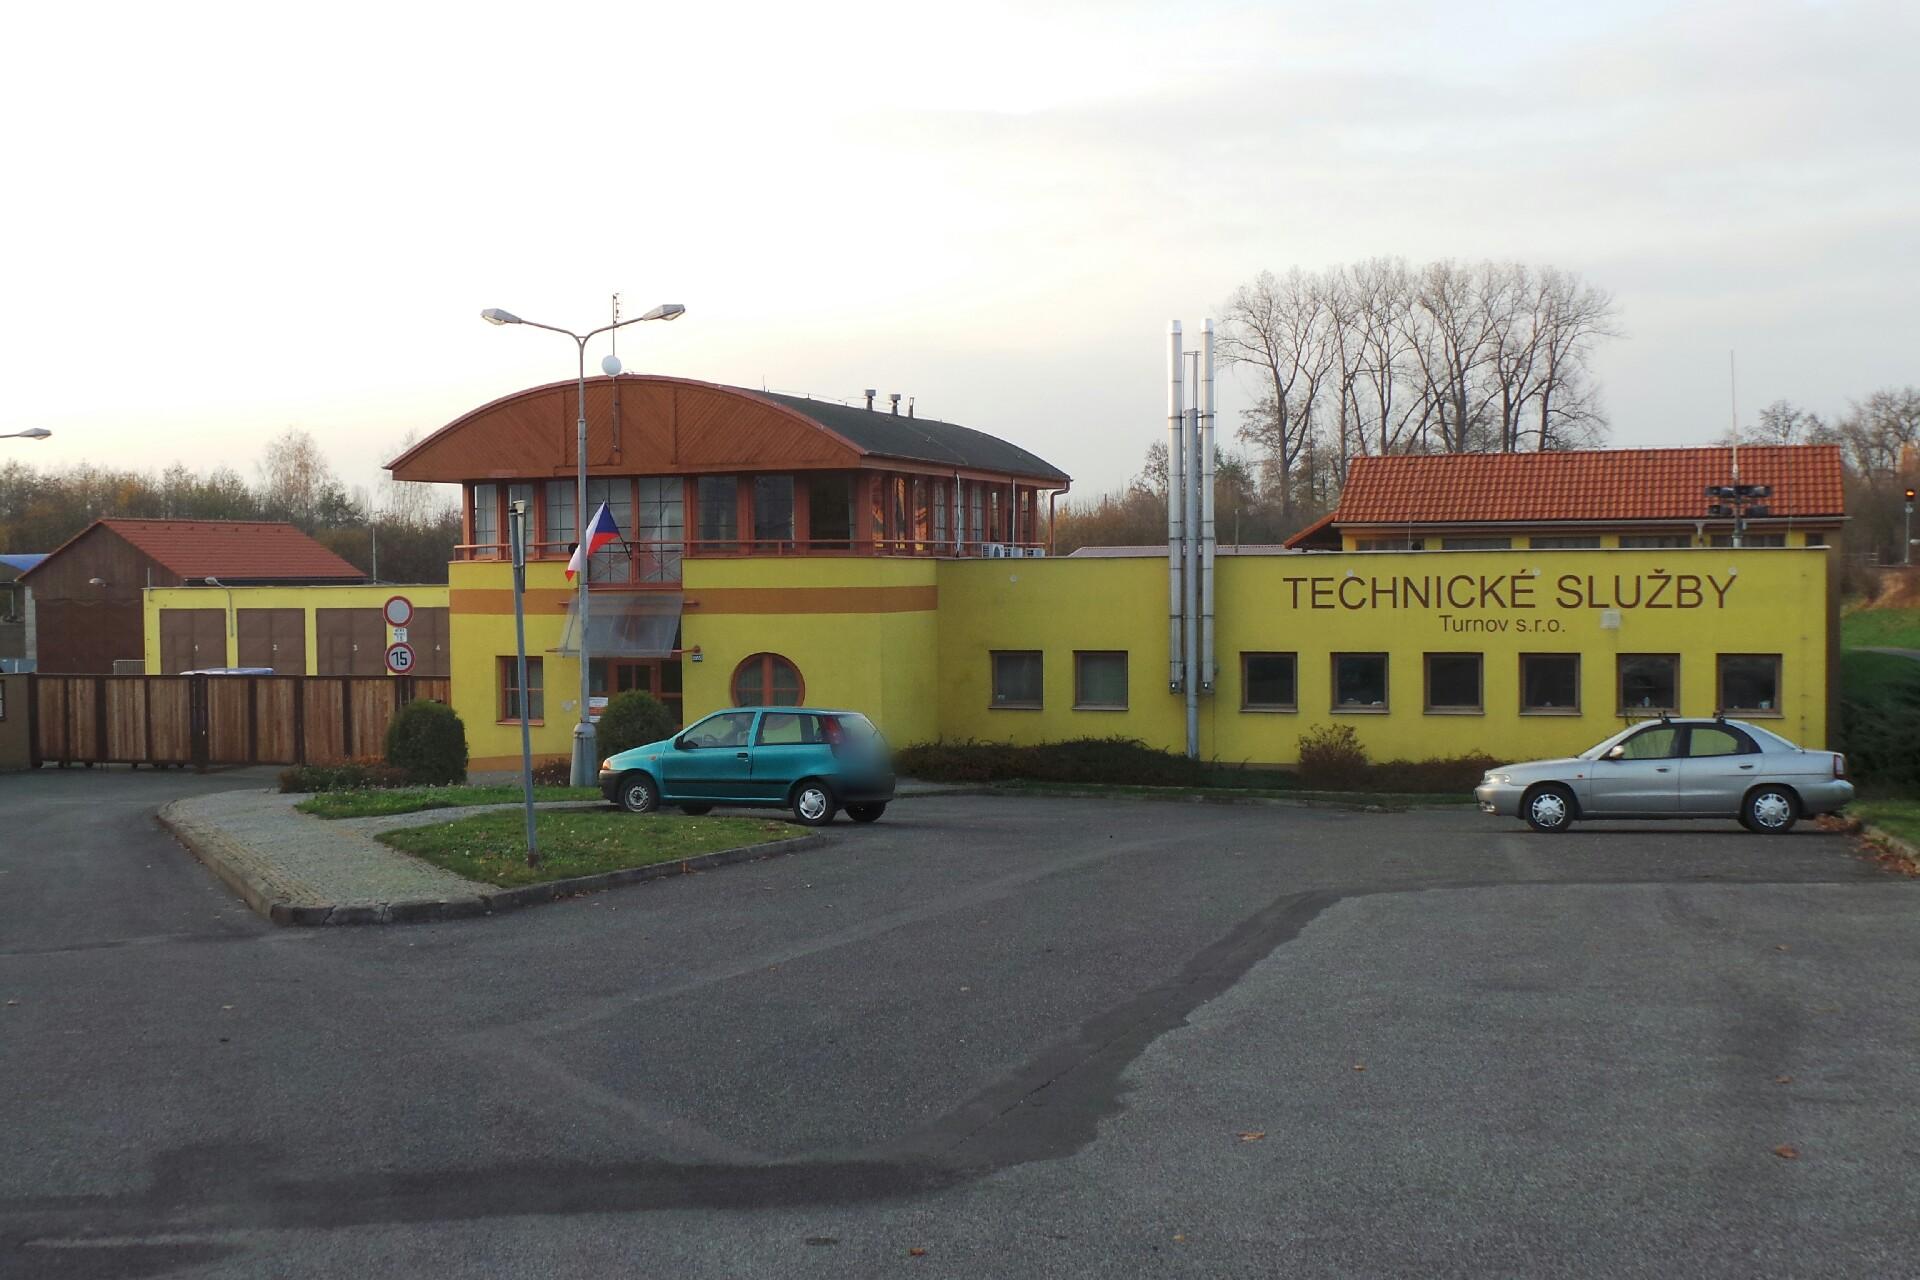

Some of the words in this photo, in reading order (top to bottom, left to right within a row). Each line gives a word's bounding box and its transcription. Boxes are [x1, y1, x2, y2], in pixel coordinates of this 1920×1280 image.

[1282, 568, 1536, 610] TECHNICKÉ
[1556, 568, 1737, 610] SLUŽBY
[1438, 614, 1509, 633] Turnov
[1516, 618, 1566, 633] s.r.o.
[391, 651, 408, 666] 15
